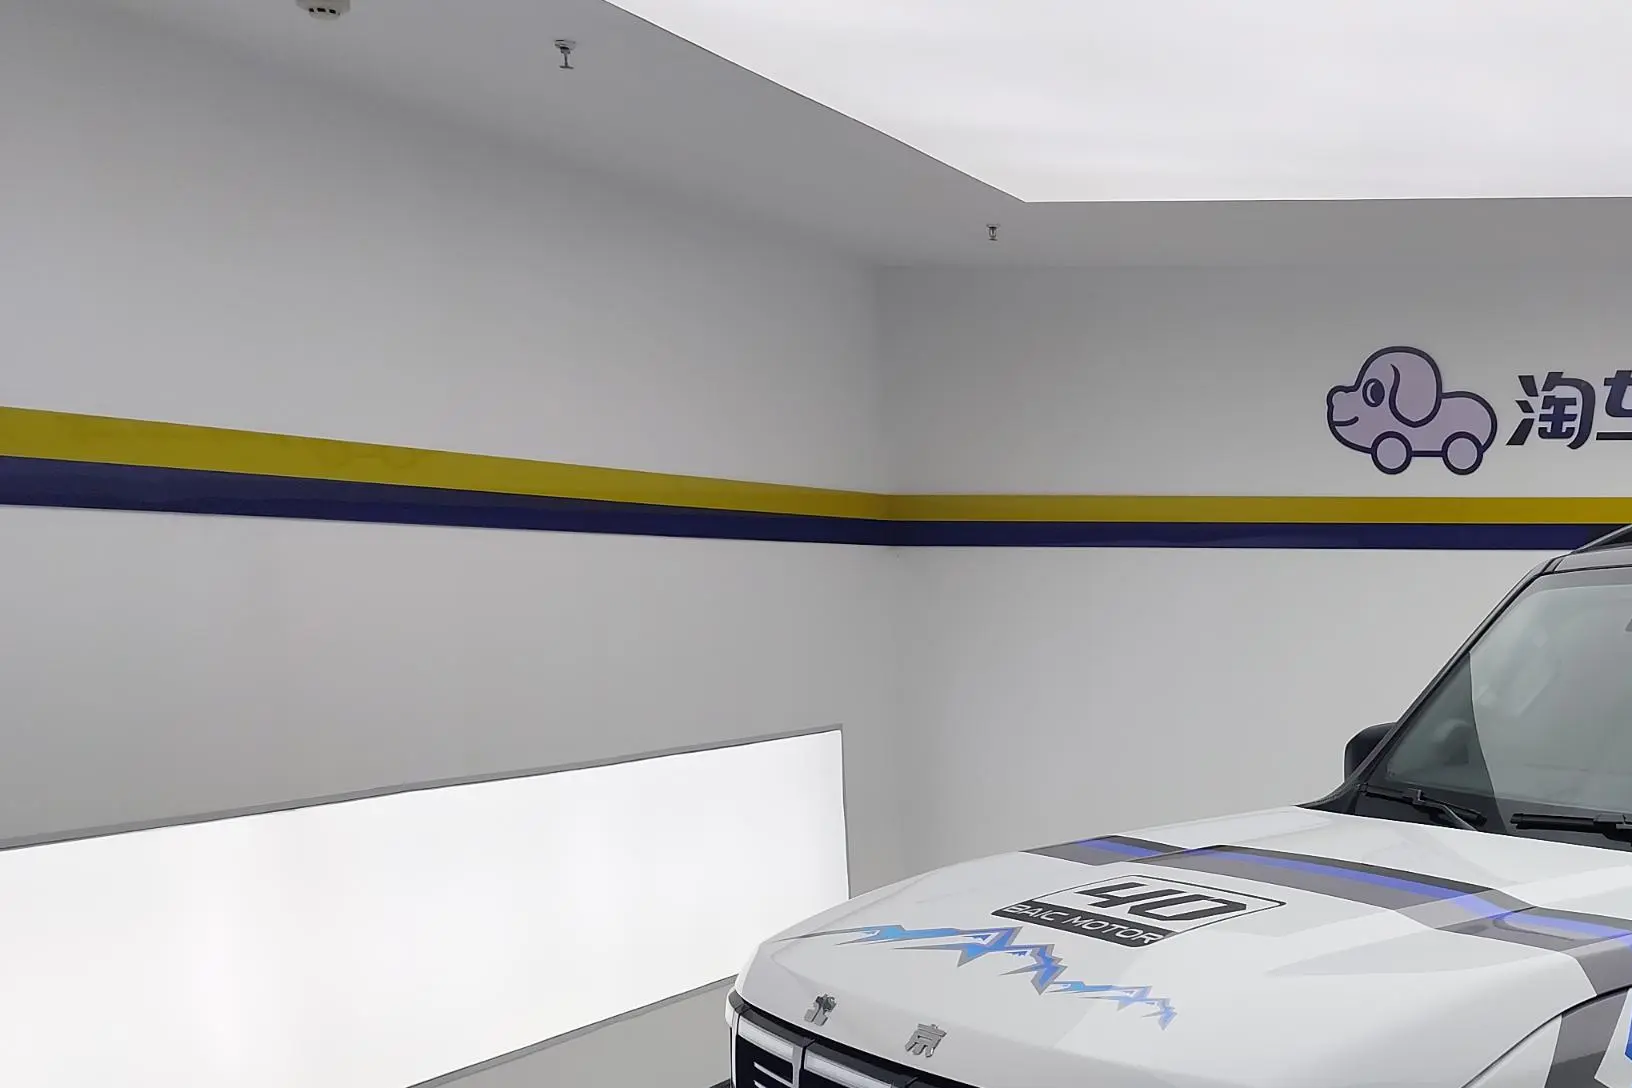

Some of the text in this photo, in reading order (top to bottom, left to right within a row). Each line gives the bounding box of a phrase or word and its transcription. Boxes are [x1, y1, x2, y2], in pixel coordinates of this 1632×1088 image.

[1074, 882, 1247, 921] 40
[1001, 904, 1168, 945] BAIC MOTOR
